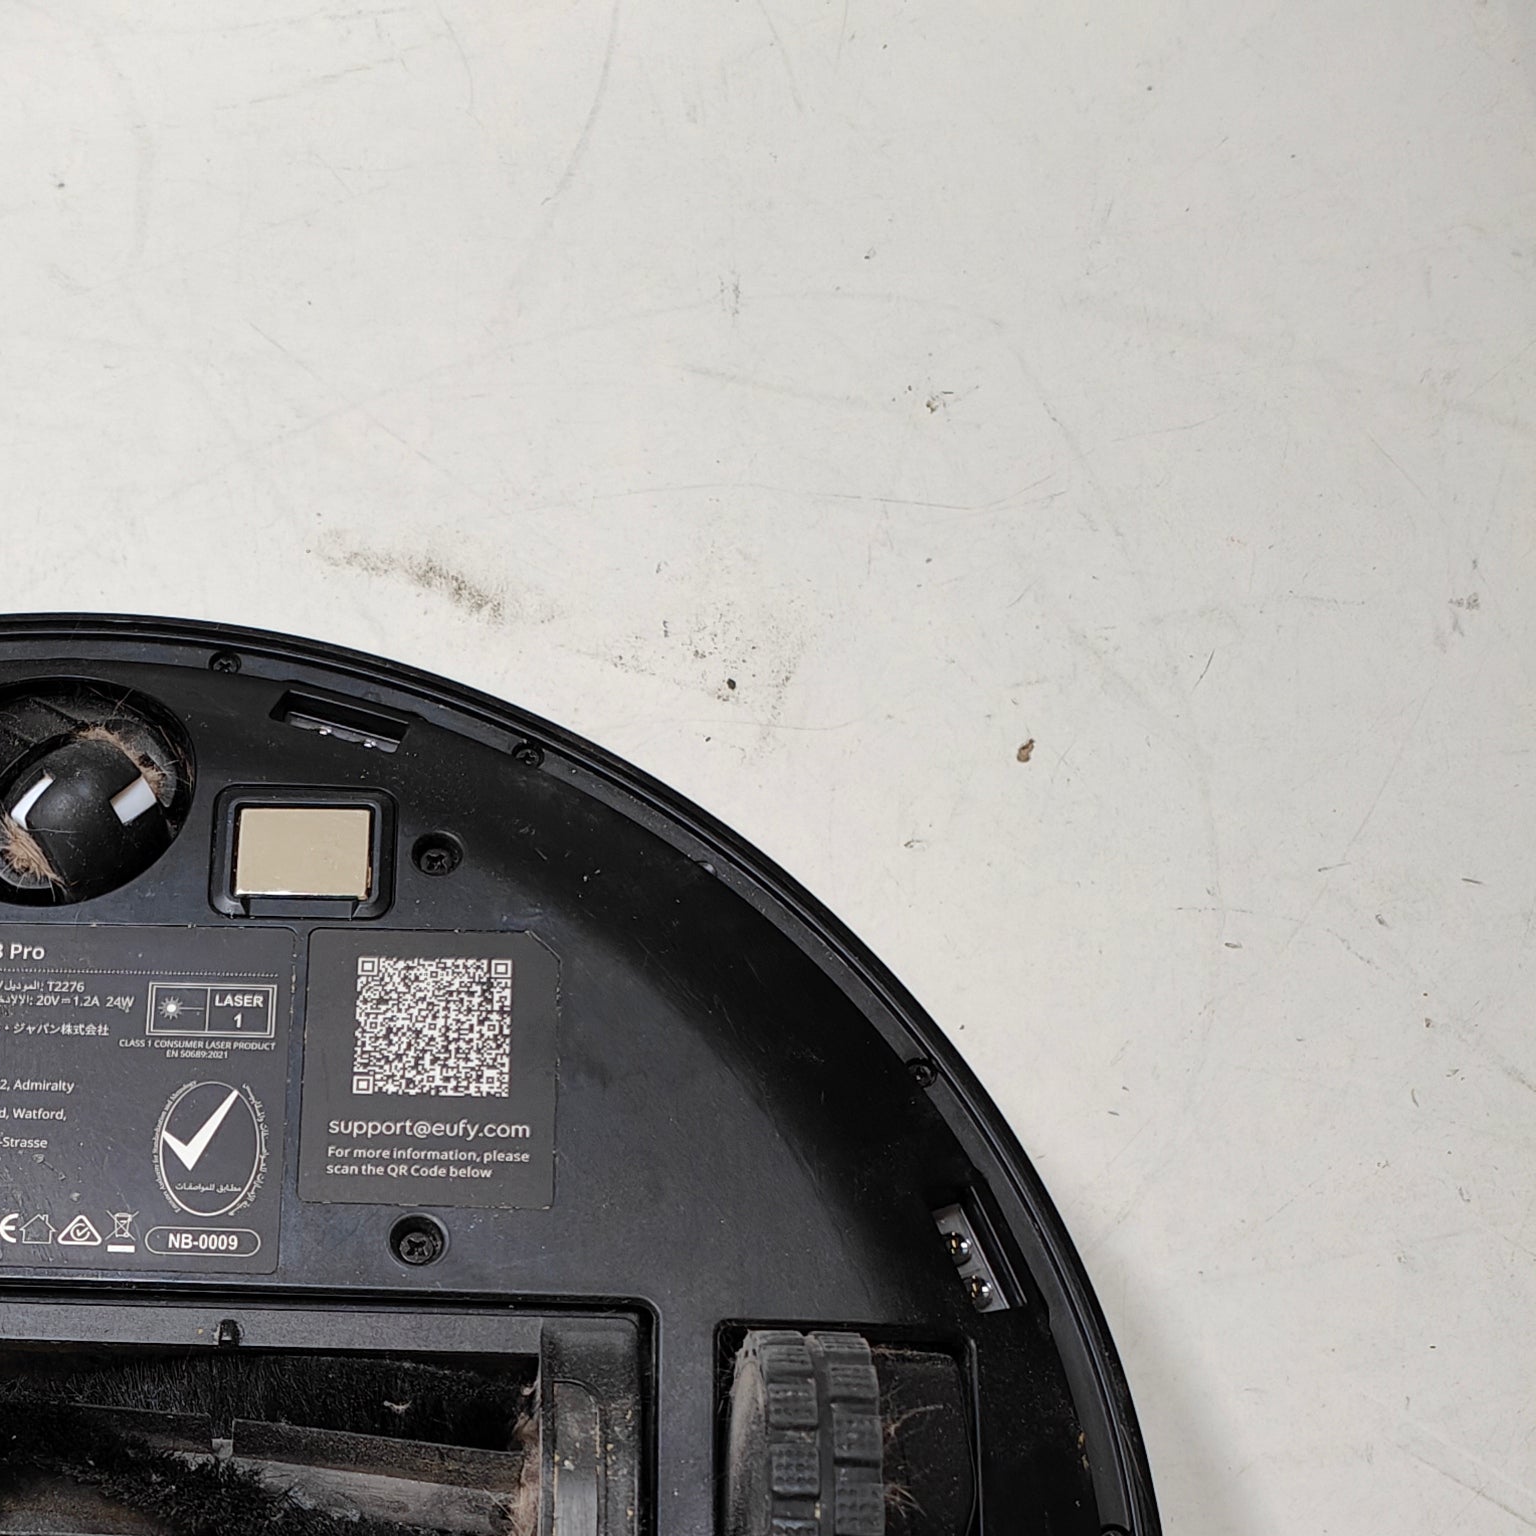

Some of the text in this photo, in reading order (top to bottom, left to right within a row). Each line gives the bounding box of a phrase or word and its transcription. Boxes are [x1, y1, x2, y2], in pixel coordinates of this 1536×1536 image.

[10, 944, 45, 960] Pro
[47, 982, 85, 992] T2276
[106, 996, 134, 1008] 24W
[215, 994, 264, 1008] LASER
[234, 1012, 242, 1028] 1
[119, 1039, 276, 1050] CLASS 1 CONSUMER LASER PRODUCT
[166, 1050, 179, 1058] EN
[0, 1079, 10, 1092] 2,
[14, 1080, 74, 1094] Admiralty
[13, 1108, 66, 1121] Watford,
[328, 1119, 530, 1140] support@eufy.com
[328, 1146, 530, 1164] For more information, please
[326, 1164, 492, 1178] scan the QR Code below
[168, 1233, 238, 1250] NB-0009
